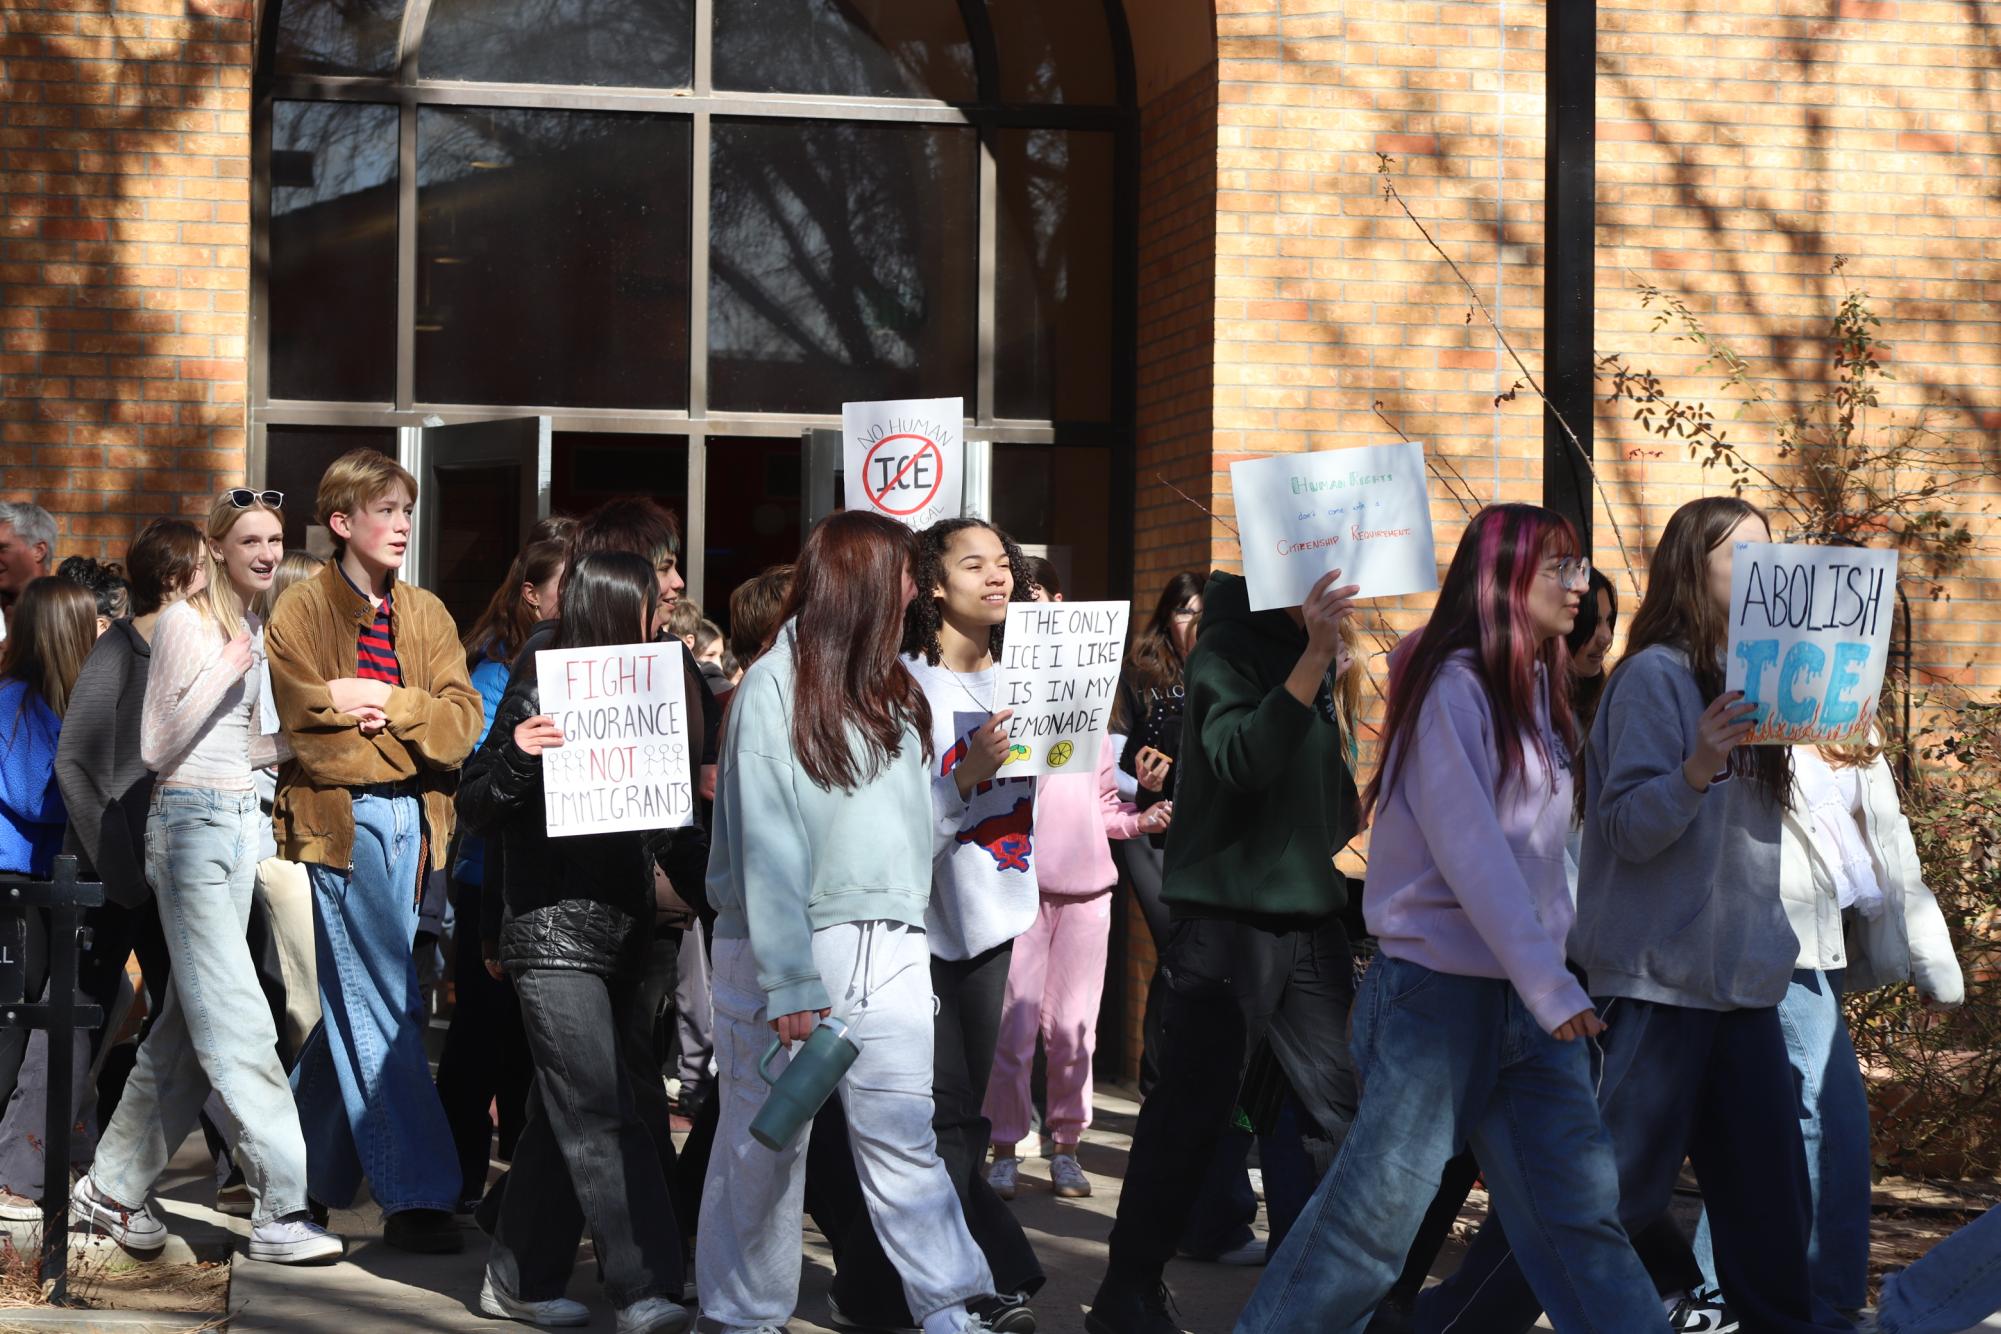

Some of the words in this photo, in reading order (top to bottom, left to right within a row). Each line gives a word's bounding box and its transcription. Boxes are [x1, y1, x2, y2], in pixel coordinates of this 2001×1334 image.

[857, 423, 885, 450] NO
[888, 417, 953, 447] HUMAN
[874, 453, 934, 492] ICE
[1740, 561, 1884, 636] ABOLISH
[1018, 610, 1065, 635] THE
[1068, 610, 1119, 636] ONLY
[1005, 644, 1041, 670] ICE
[1049, 644, 1063, 668] I
[1077, 641, 1120, 668] LIKE
[566, 654, 659, 701] FIGHT
[1007, 681, 1032, 706] IS
[1046, 679, 1075, 703] IN
[1085, 675, 1115, 699] MY
[1726, 639, 1871, 728] ICE
[589, 745, 638, 783] NOT
[547, 781, 692, 827] IMMIGRANTS
